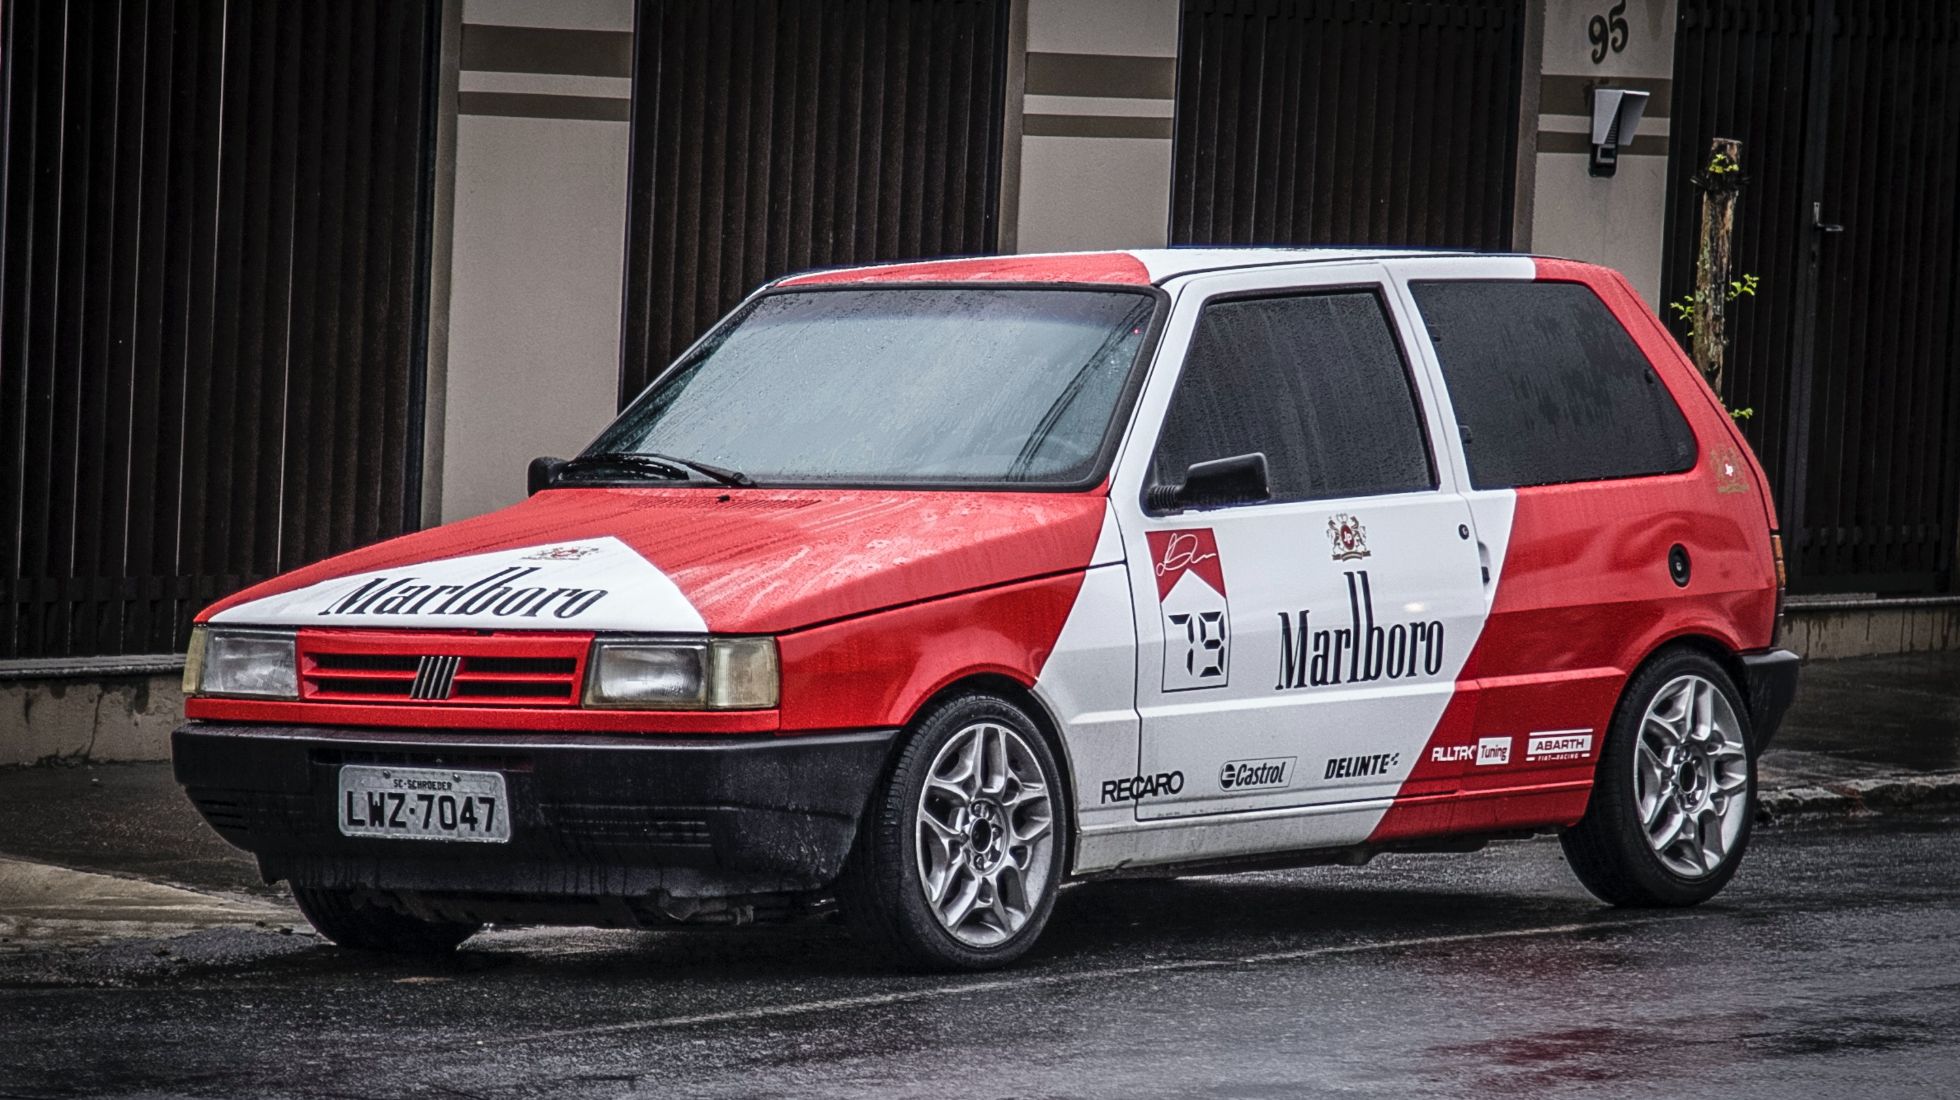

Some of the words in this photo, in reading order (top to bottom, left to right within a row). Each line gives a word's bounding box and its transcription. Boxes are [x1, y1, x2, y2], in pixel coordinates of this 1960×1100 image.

[1588, 0, 1629, 65] 95
[317, 565, 610, 619] Marlboro
[1167, 610, 1226, 679] 79
[1274, 569, 1445, 691] Marlboro
[1480, 744, 1508, 762] Tuning
[1535, 738, 1586, 752] ABARTH
[1234, 760, 1288, 788] Castrol
[1323, 753, 1391, 780] DELINTE
[1100, 769, 1185, 805] RECARO
